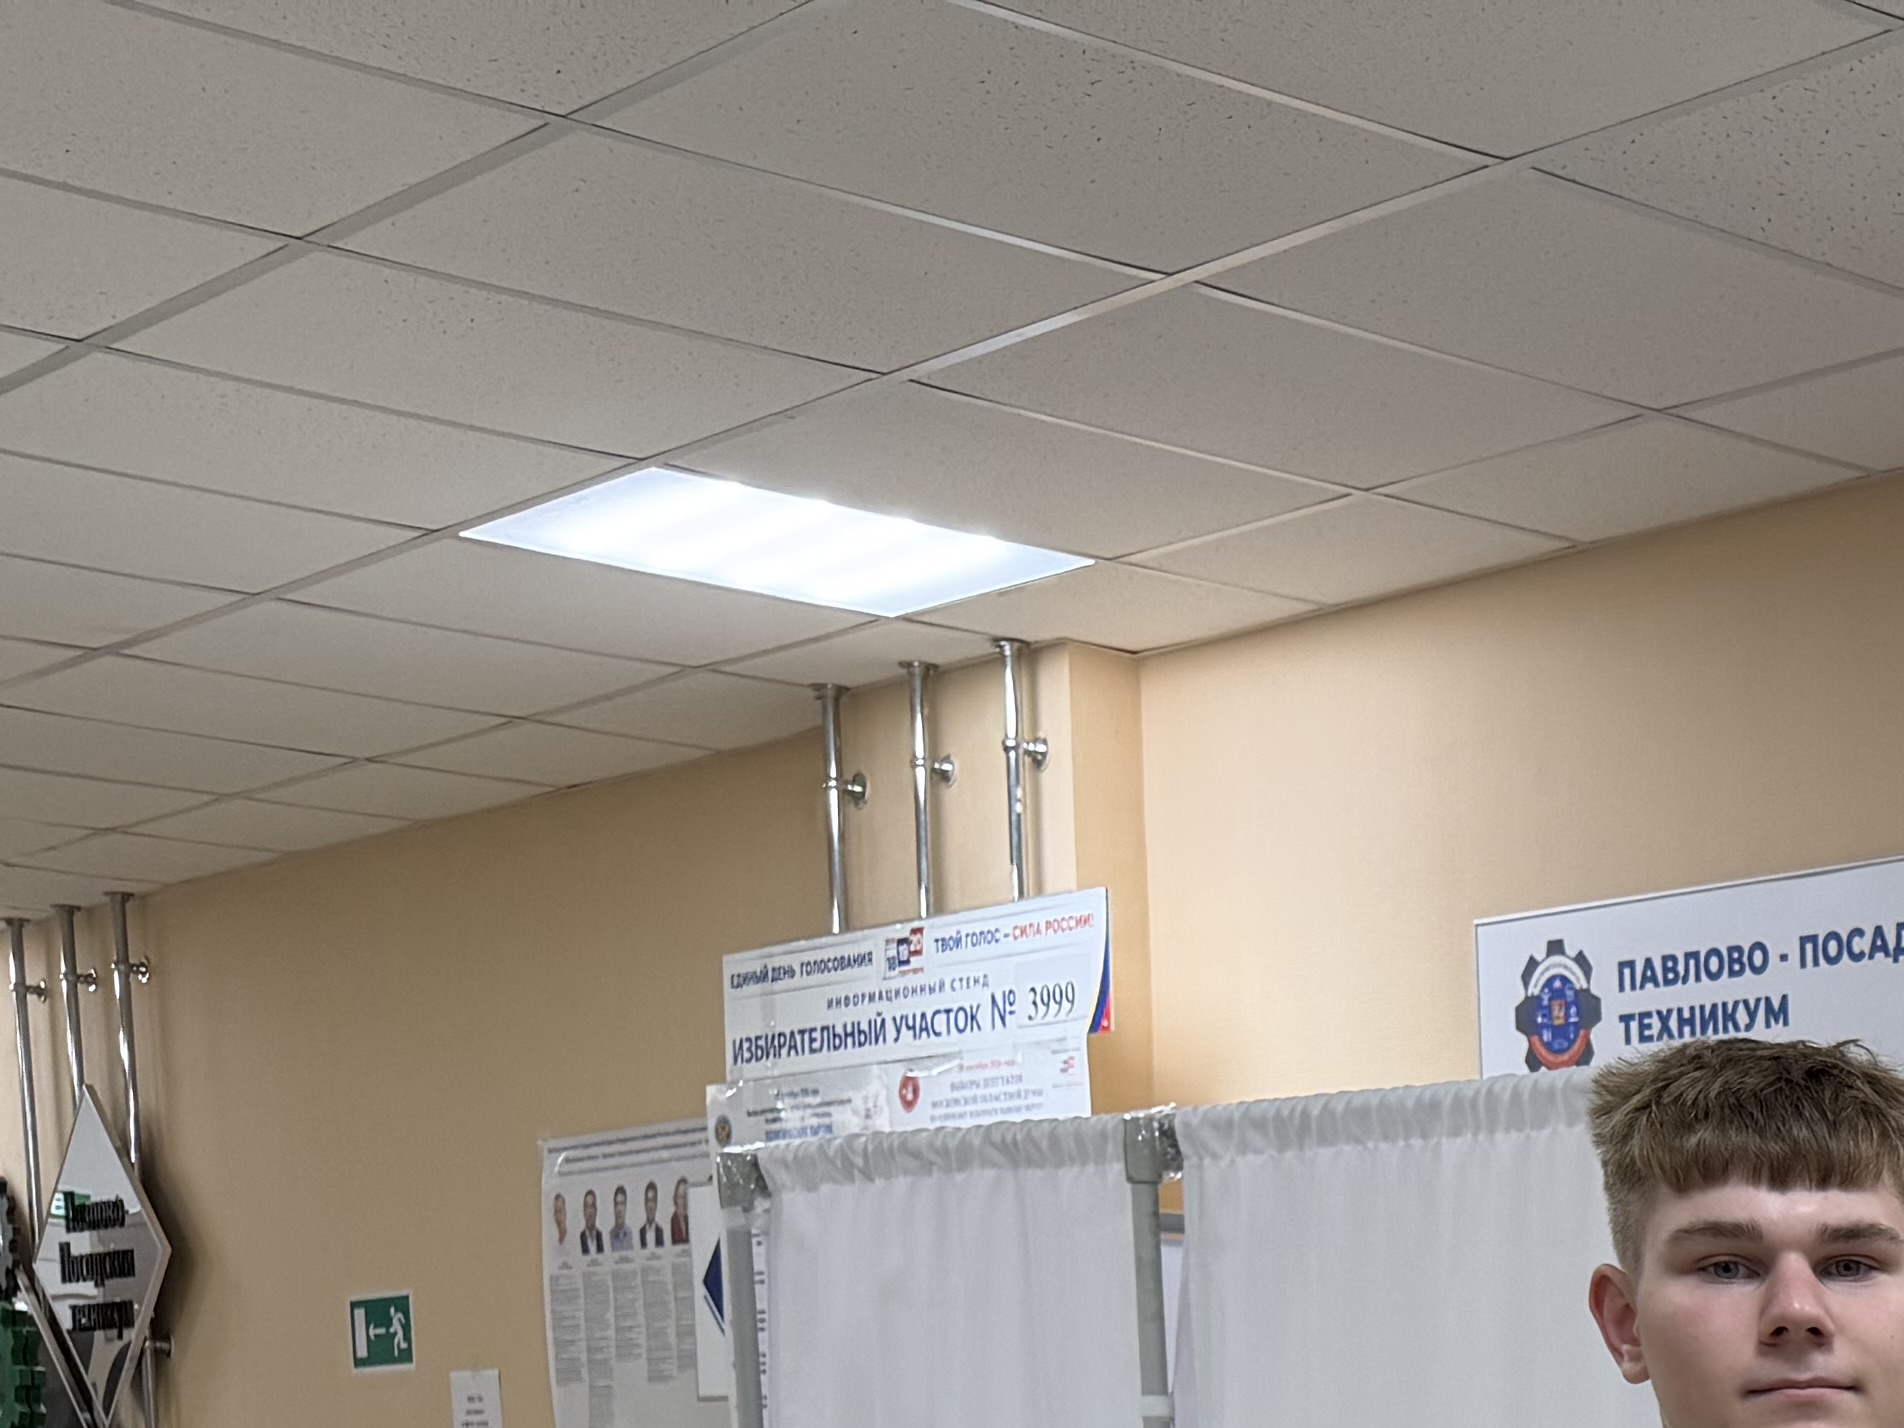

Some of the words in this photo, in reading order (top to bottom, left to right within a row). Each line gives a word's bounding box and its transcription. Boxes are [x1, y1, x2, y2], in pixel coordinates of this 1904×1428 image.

[934, 931, 963, 953] ТВОЙ
[965, 928, 1000, 948] ГОЛОС
[1012, 923, 1042, 940] СИЛА
[1045, 913, 1094, 935] РОССИИ!
[730, 965, 769, 990] ЕДИНЫЙ
[770, 964, 796, 984] ДЕНЬ
[800, 951, 873, 978] ГОЛОСОВАНИЯ
[1616, 940, 1770, 993] ПАВЛОВО
[827, 977, 946, 1010] ИНФОРМАЦИОННЫЙ
[950, 974, 989, 992] СТЕНД
[732, 1011, 887, 1066] ИЗБИРАТЕЛЬНЫЙ
[892, 1003, 982, 1044] УЧАСТОК
[990, 989, 1016, 1031] №
[1027, 981, 1076, 1022] 3999
[1618, 994, 1790, 1046] ТЕХНИКУМ
